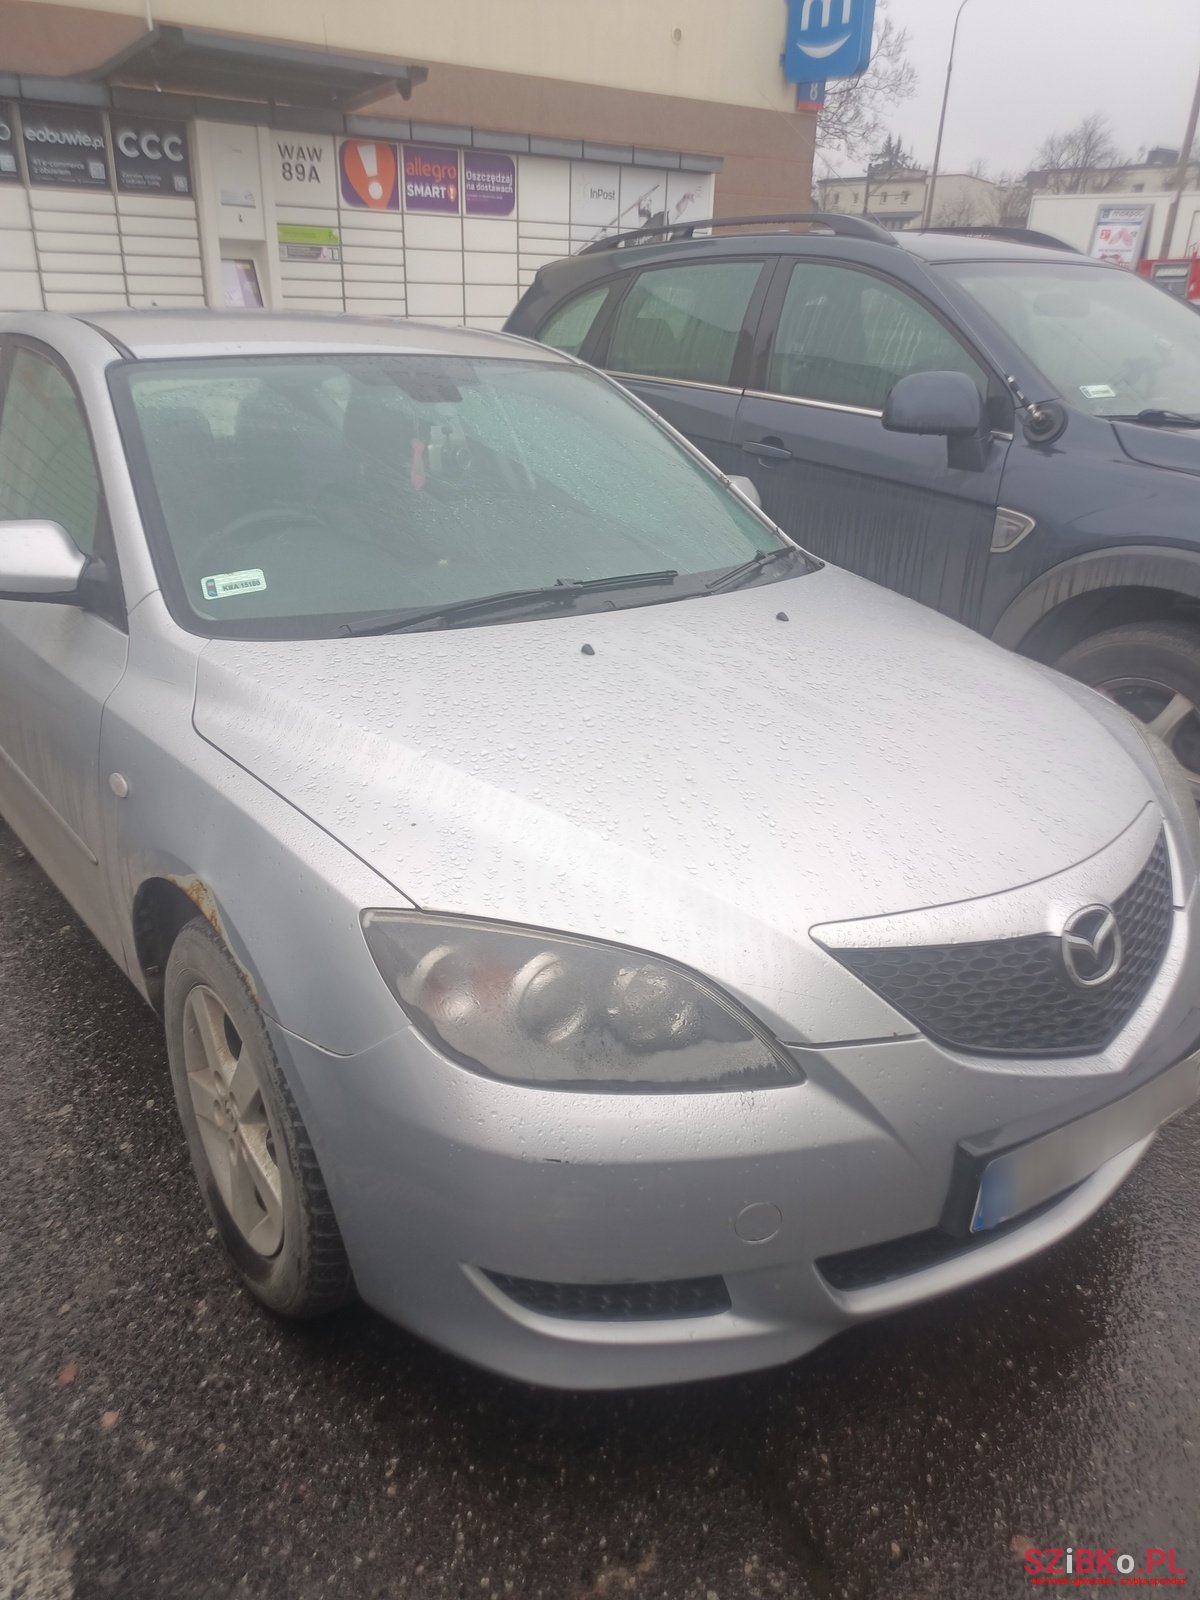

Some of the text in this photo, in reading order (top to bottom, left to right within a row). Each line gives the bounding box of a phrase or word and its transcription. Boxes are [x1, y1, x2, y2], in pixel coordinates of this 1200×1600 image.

[25, 126, 104, 149] eobuwie.pl
[118, 131, 184, 162] CCC
[277, 142, 322, 163] WAW
[281, 162, 320, 183] 89A
[406, 157, 457, 182] allegro
[466, 170, 513, 185] Oszczędzaj
[466, 183, 513, 193] na dostawach
[590, 188, 616, 200] InPost
